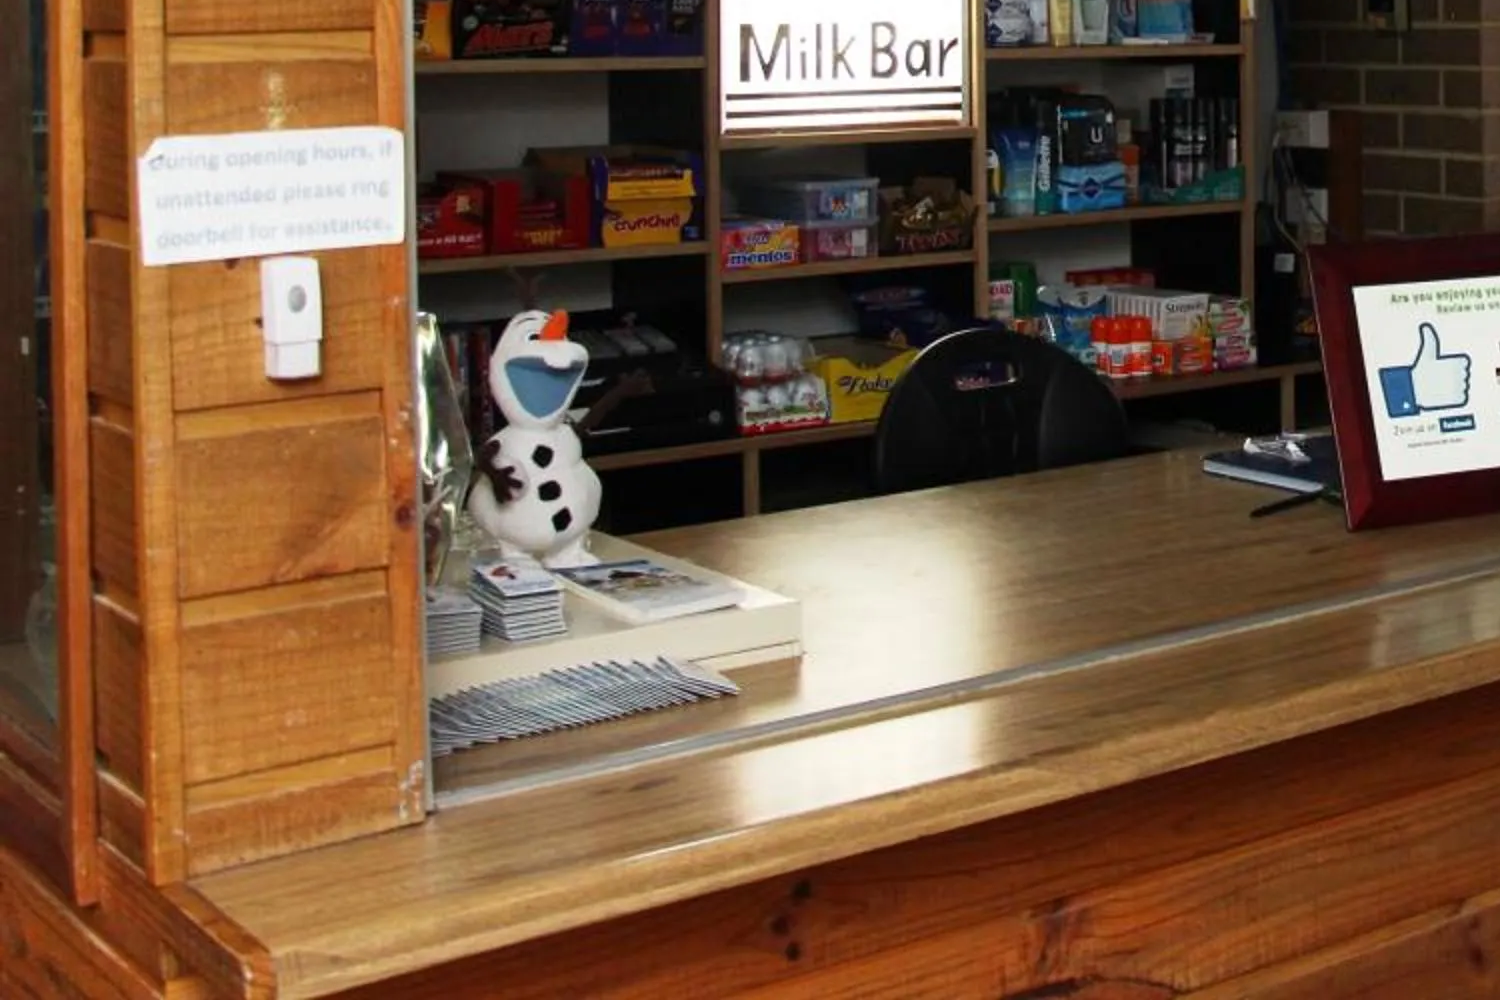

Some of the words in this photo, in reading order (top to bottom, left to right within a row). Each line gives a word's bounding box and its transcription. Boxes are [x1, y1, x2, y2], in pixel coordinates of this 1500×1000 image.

[739, 22, 856, 82] Milk
[871, 21, 959, 79] Bar
[225, 145, 307, 168] opening
[156, 184, 277, 210] unattended
[282, 182, 346, 205] please
[352, 180, 391, 200] ring
[156, 223, 244, 250] doorbell
[249, 221, 279, 242] for
[731, 250, 793, 265] mentos
[1391, 294, 1410, 304] Are
[1412, 293, 1433, 305] you
[1436, 288, 1482, 302] enjoying
